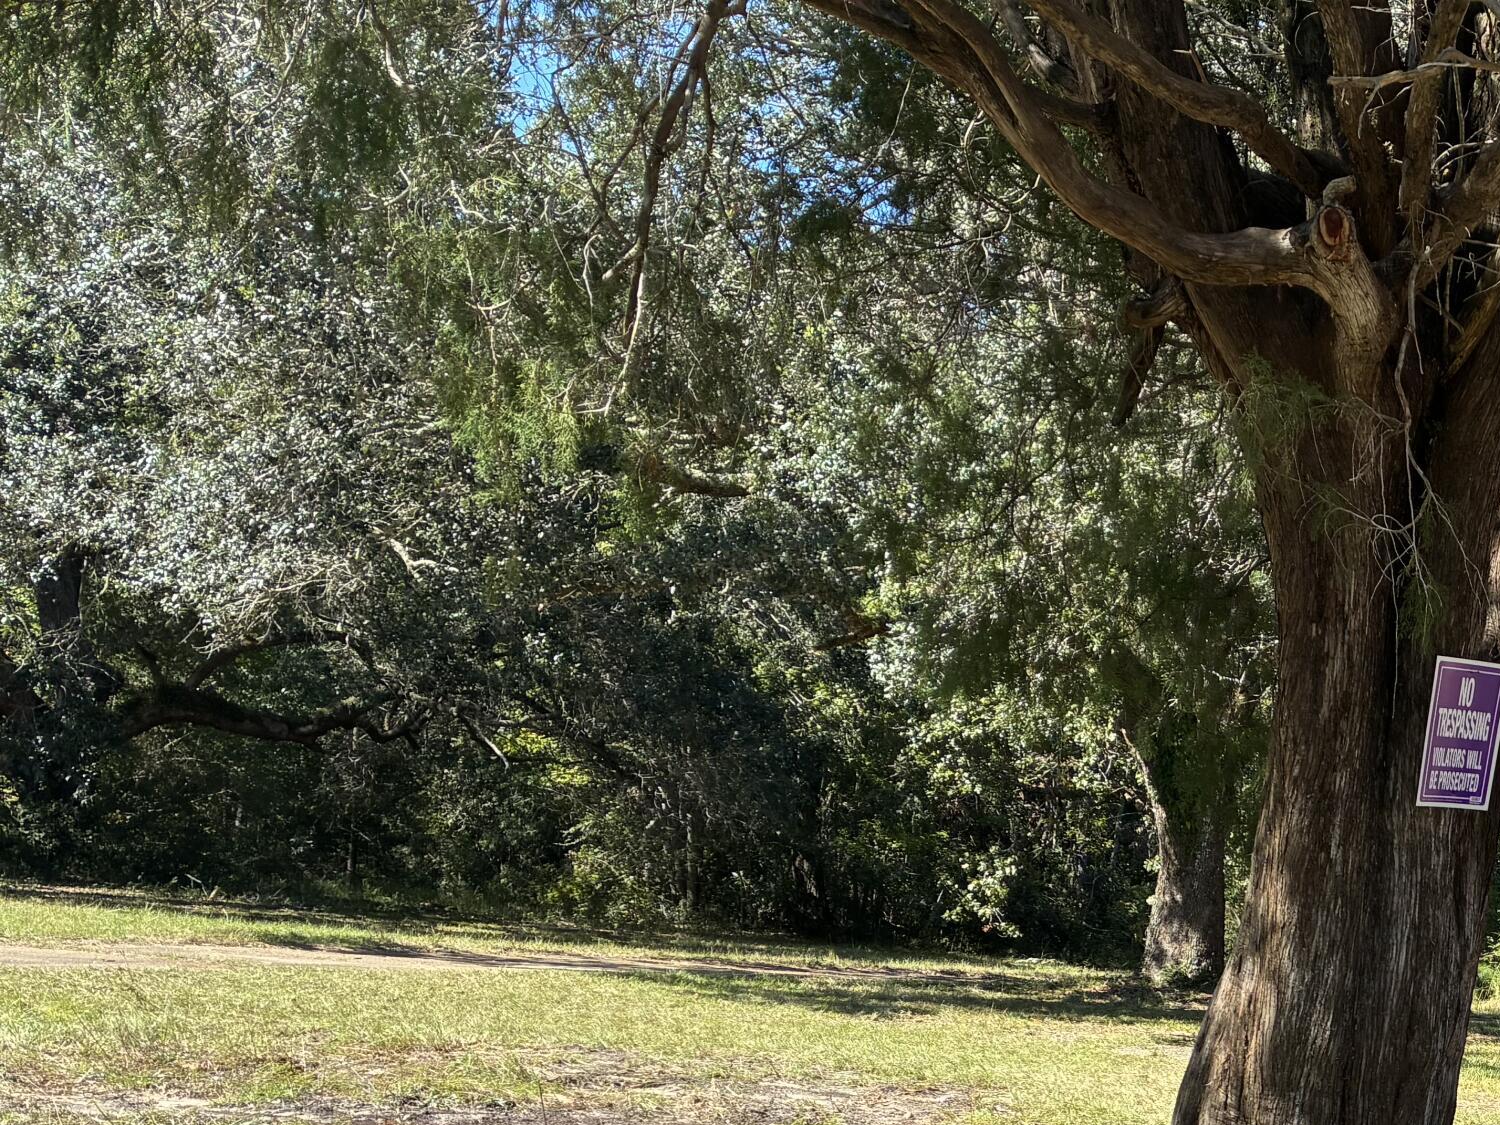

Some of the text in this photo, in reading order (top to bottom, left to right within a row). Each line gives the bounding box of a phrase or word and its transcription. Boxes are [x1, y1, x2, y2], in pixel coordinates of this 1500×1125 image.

[1458, 677, 1476, 707] NO
[1437, 708, 1491, 741] TRESPASSING
[1432, 747, 1482, 770] VIOLATORS WILL
[1429, 770, 1480, 793] BE PROSECUTED
